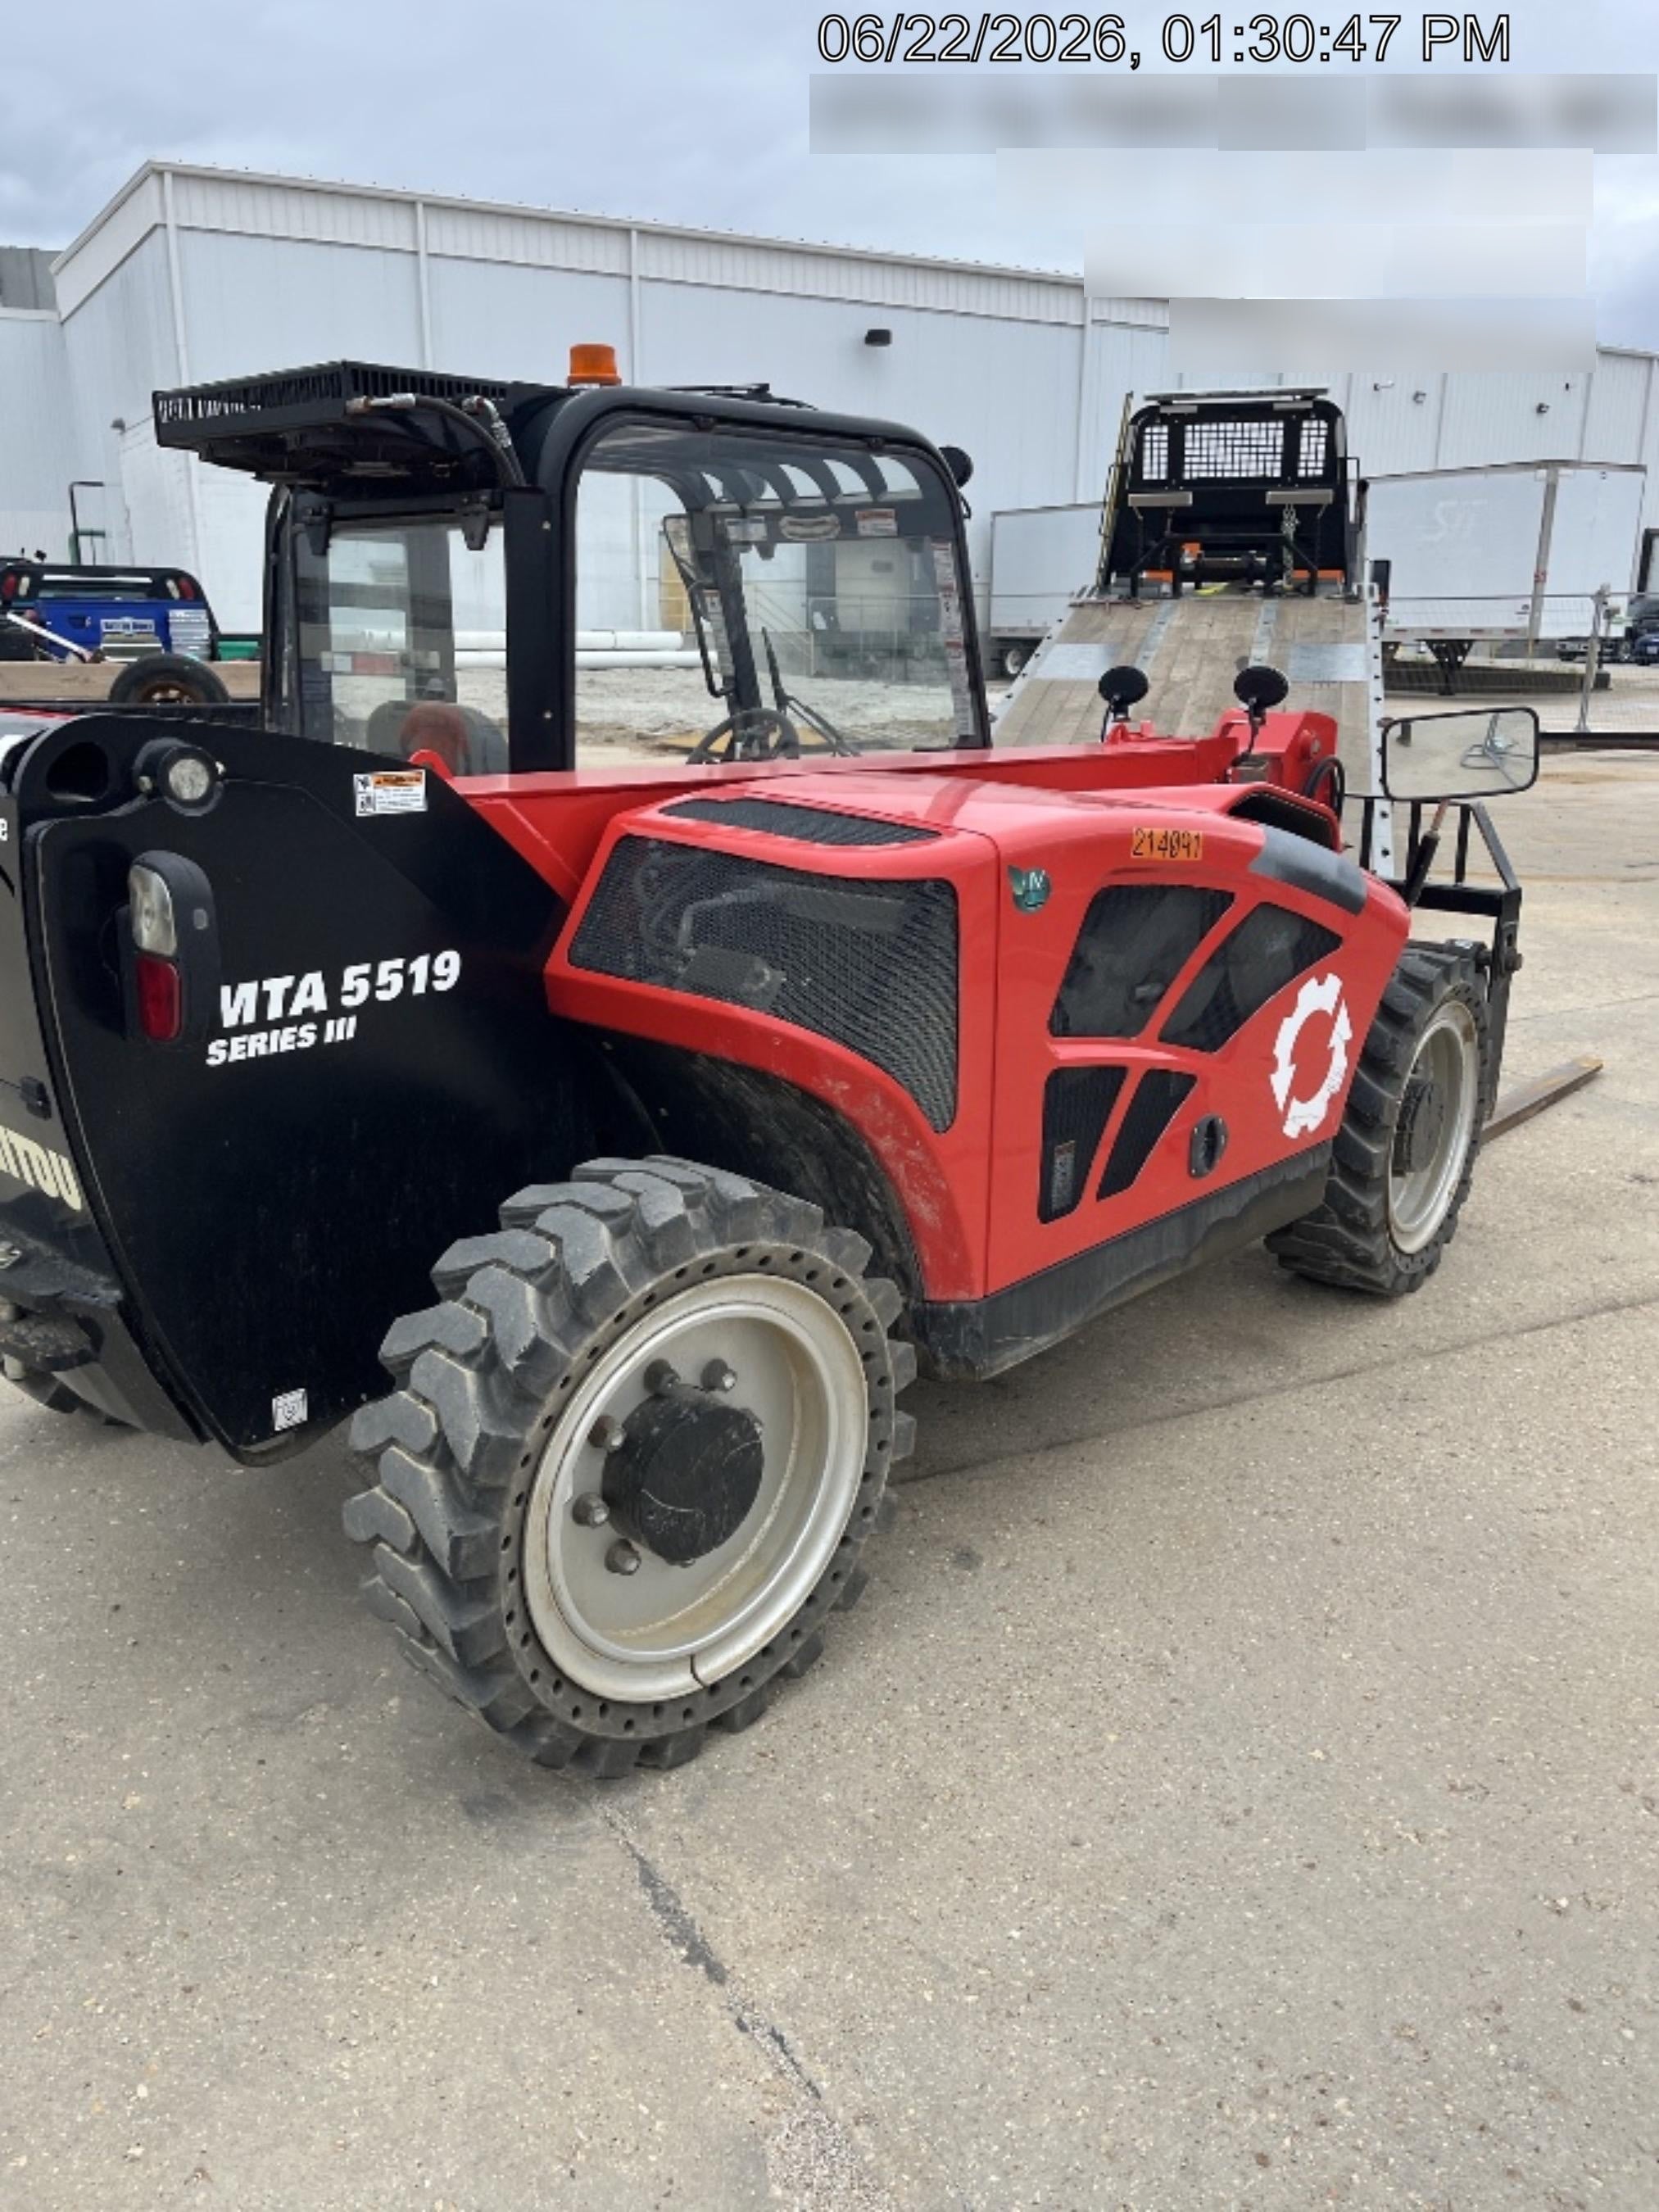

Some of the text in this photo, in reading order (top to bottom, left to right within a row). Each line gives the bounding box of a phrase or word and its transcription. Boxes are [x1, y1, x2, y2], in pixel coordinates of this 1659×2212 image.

[1132, 827, 1201, 859] 214091
[340, 950, 461, 1008] 5519
[205, 1014, 357, 1067] SERIES III
